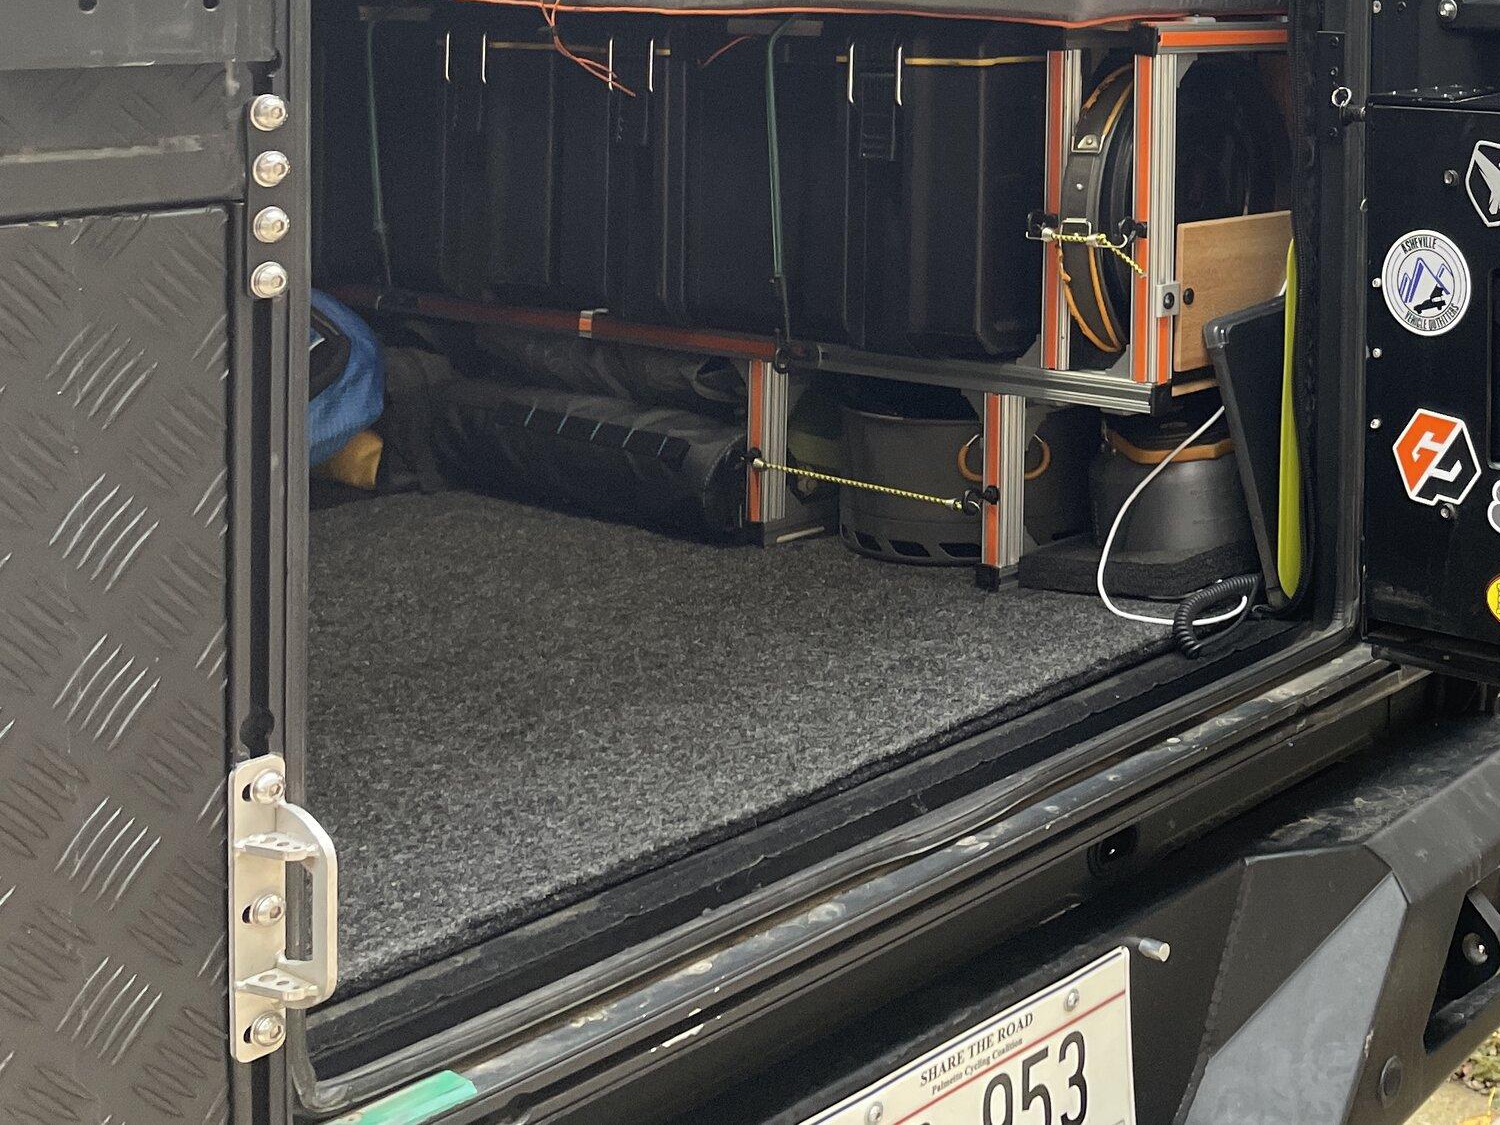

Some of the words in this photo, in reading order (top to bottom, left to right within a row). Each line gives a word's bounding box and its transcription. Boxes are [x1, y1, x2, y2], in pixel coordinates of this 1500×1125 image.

[1400, 236, 1437, 254] ASHEVILLE
[1405, 310, 1427, 330] VEHICLE
[1429, 303, 1459, 330] OUTFITTERS
[920, 1051, 965, 1087] SHARE
[967, 1034, 995, 1059] THE
[997, 1012, 1034, 1041] ROAD
[964, 1054, 991, 1078] Cycling
[992, 1037, 1023, 1062] Coalition
